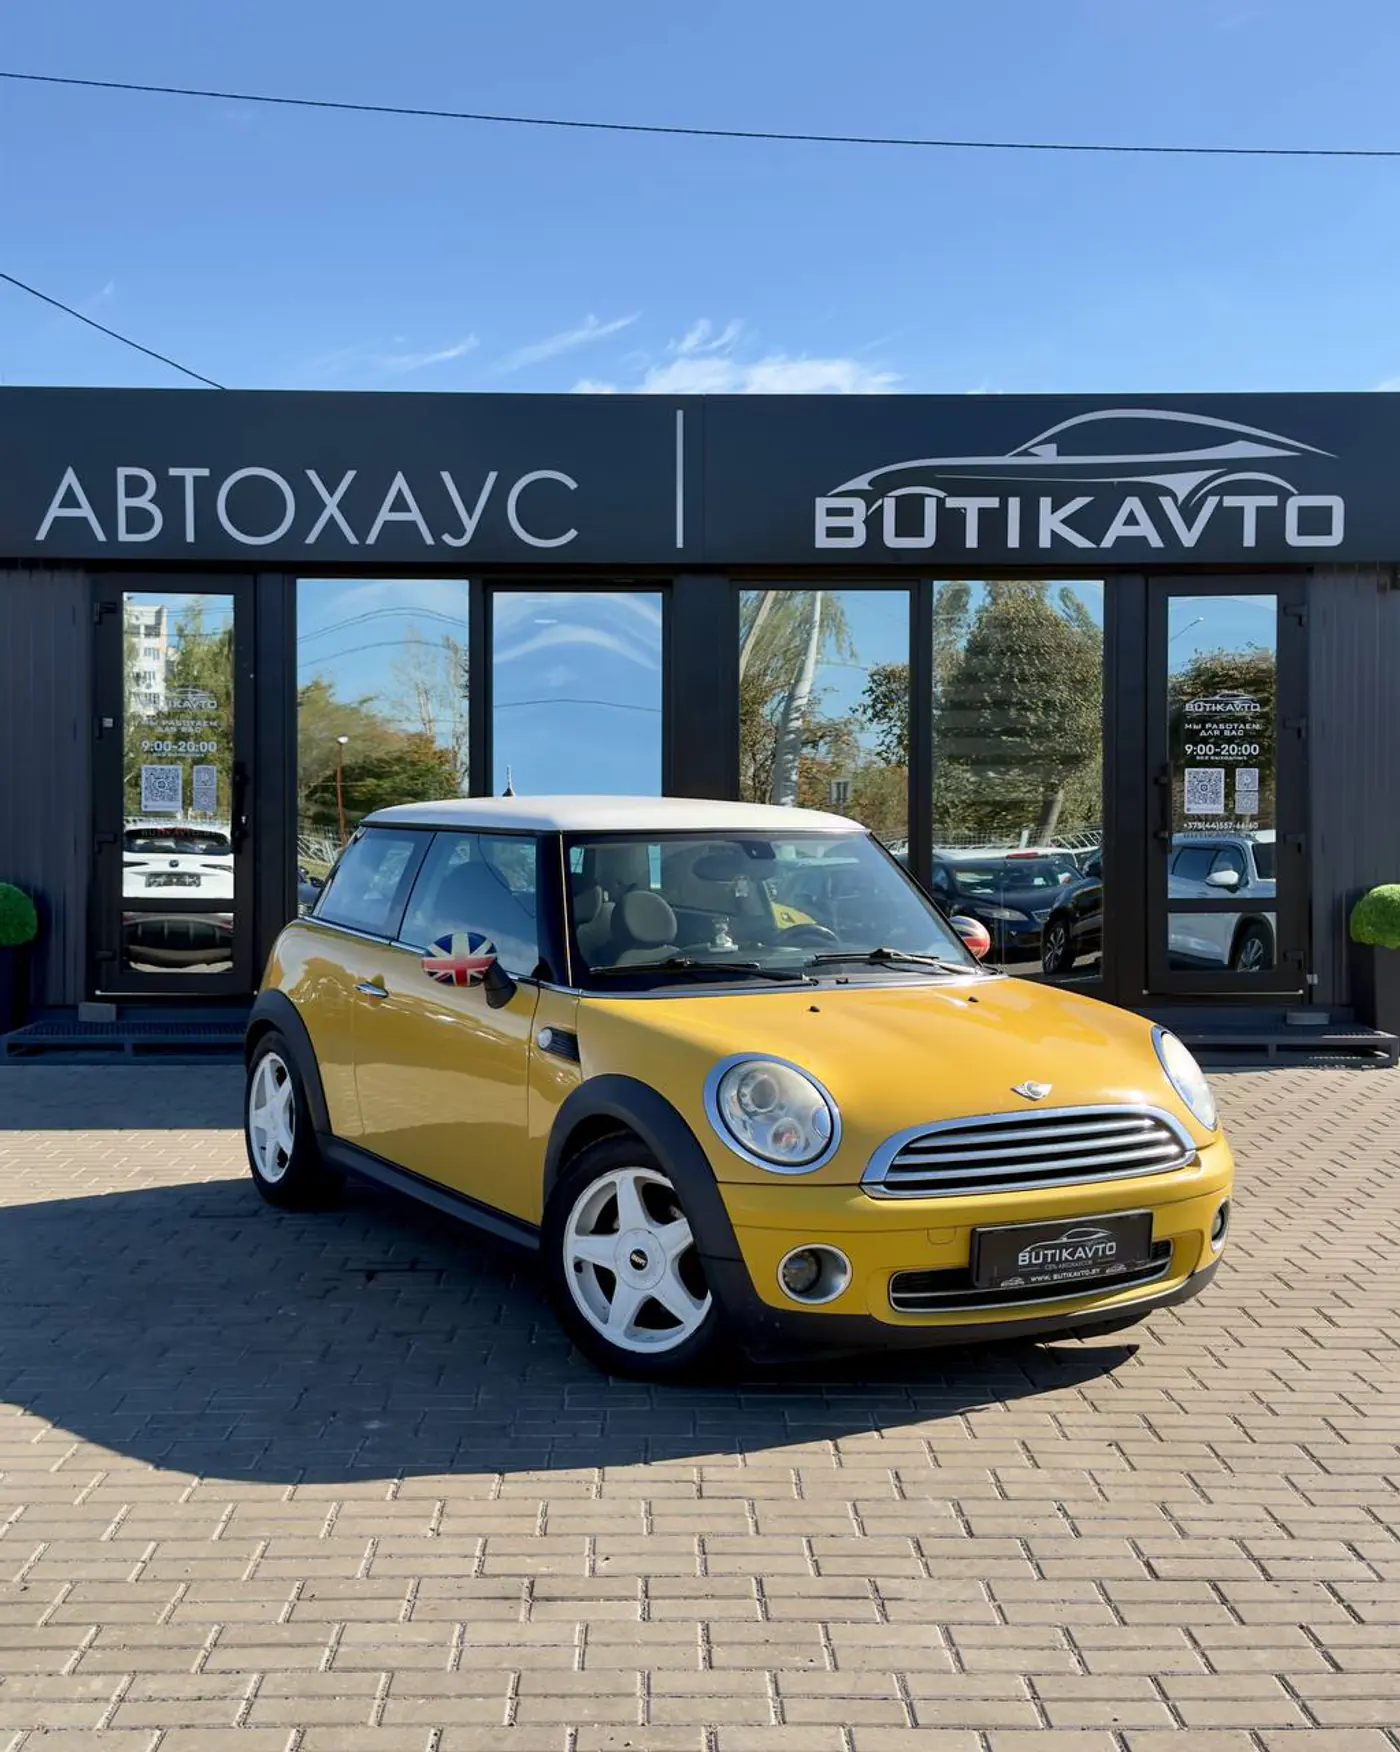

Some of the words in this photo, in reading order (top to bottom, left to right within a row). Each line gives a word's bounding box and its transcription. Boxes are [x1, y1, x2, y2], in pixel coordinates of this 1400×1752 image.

[35, 465, 579, 548] АВТОХАУС
[815, 495, 1345, 549] BUTIKAVTO
[1185, 703, 1260, 712] BUTIKAVTO
[142, 740, 217, 752] 9:00-20:00
[1184, 744, 1260, 755] 9:00-20:00
[1018, 1242, 1116, 1265] BUTIKAVTO
